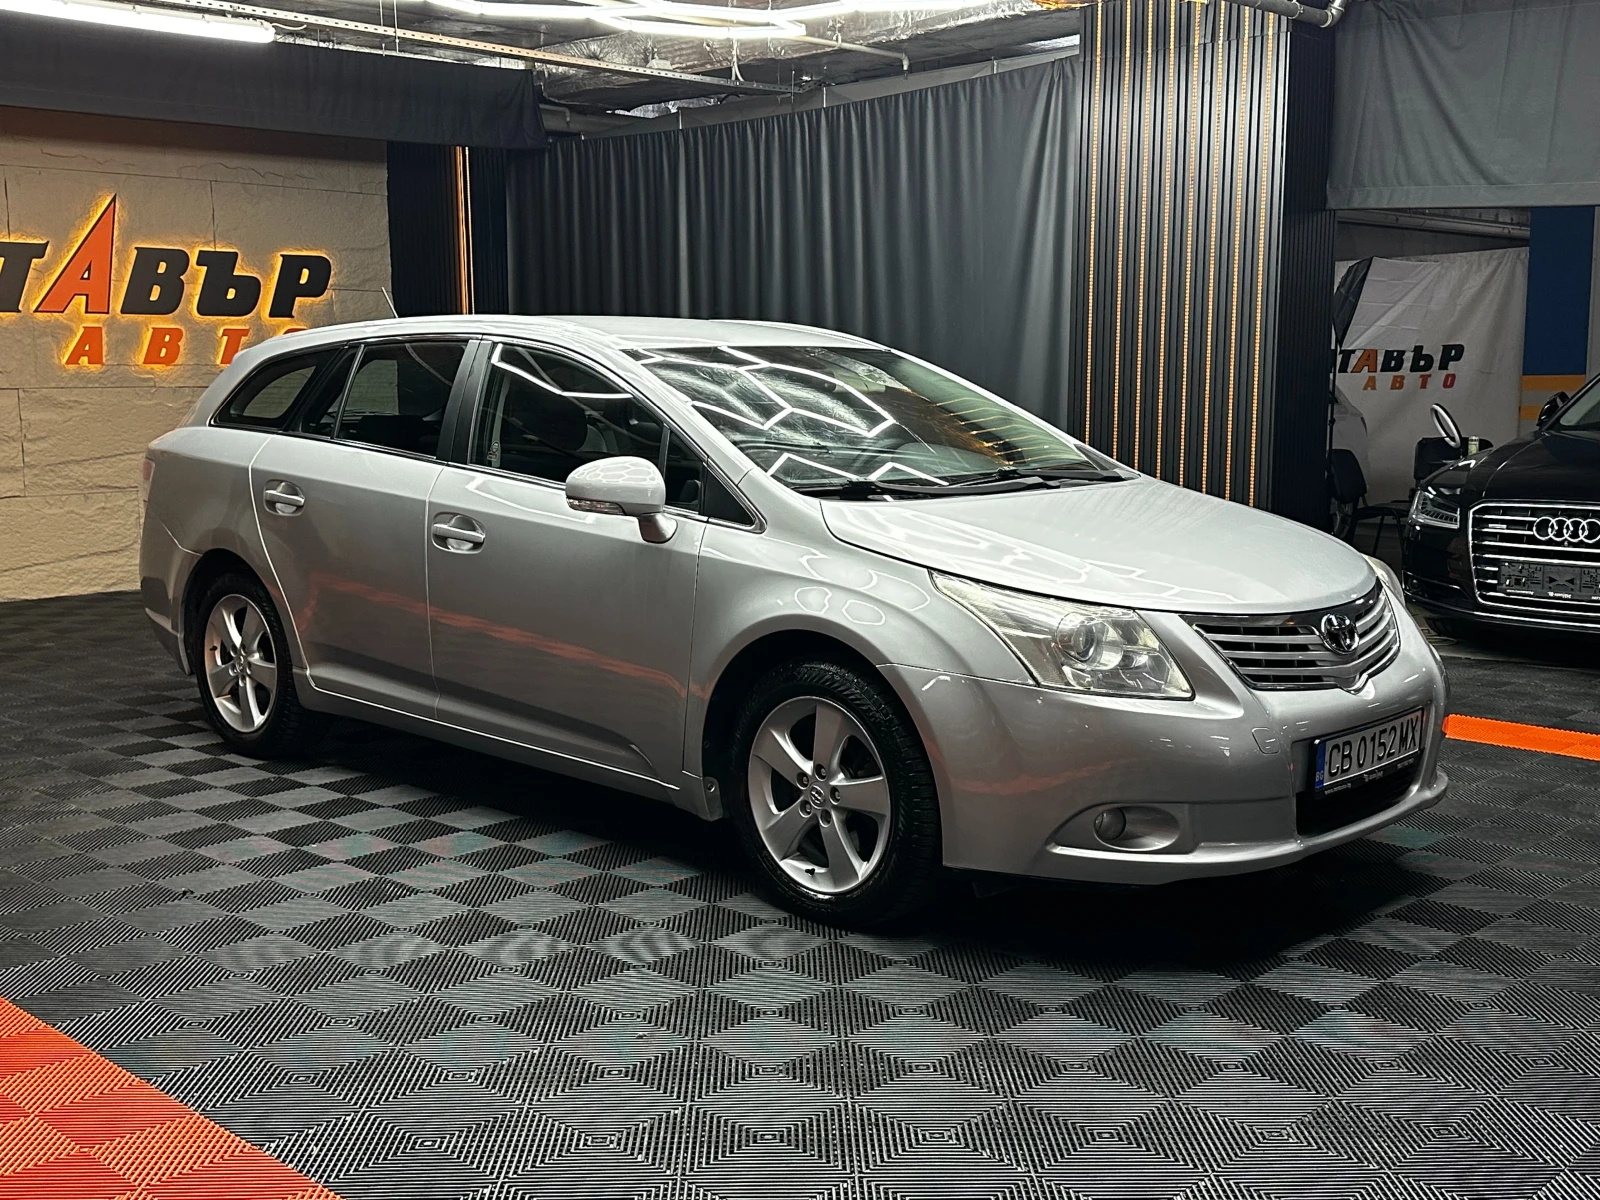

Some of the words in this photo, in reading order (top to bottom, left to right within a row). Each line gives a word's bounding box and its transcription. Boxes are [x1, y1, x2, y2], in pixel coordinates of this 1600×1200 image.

[64, 326, 308, 366] АВТ
[1363, 373, 1456, 390] АВТО
[1357, 725, 1397, 768] 0152
[1315, 770, 1324, 782] BG
